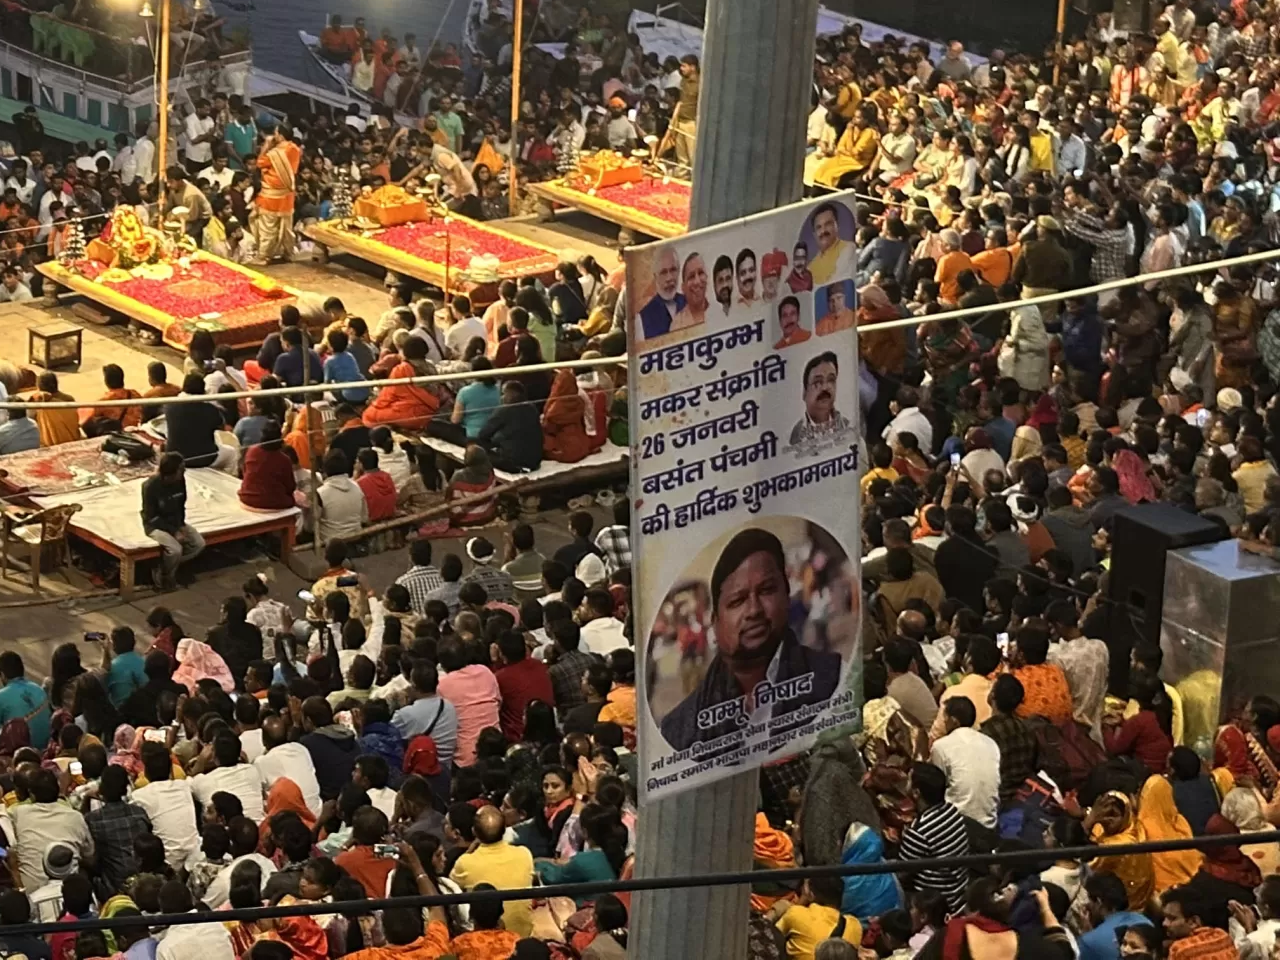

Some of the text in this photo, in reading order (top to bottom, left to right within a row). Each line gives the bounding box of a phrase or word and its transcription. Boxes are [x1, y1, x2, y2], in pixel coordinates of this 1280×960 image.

[640, 319, 765, 374] महाकुम्भ
[640, 354, 787, 420] मकर संक्रांति
[641, 433, 665, 460] 26
[670, 400, 759, 449] जनवरी
[641, 459, 705, 494] बसंत
[710, 431, 778, 473] पंचमी
[641, 503, 670, 536] की
[674, 486, 738, 528] हार्दिक
[743, 445, 859, 513] शुभकामनायें
[698, 673, 813, 728] शम्भू निषाद
[646, 770, 679, 792] निषाद
[681, 760, 714, 781] समाज
[715, 746, 750, 769] भाजपा
